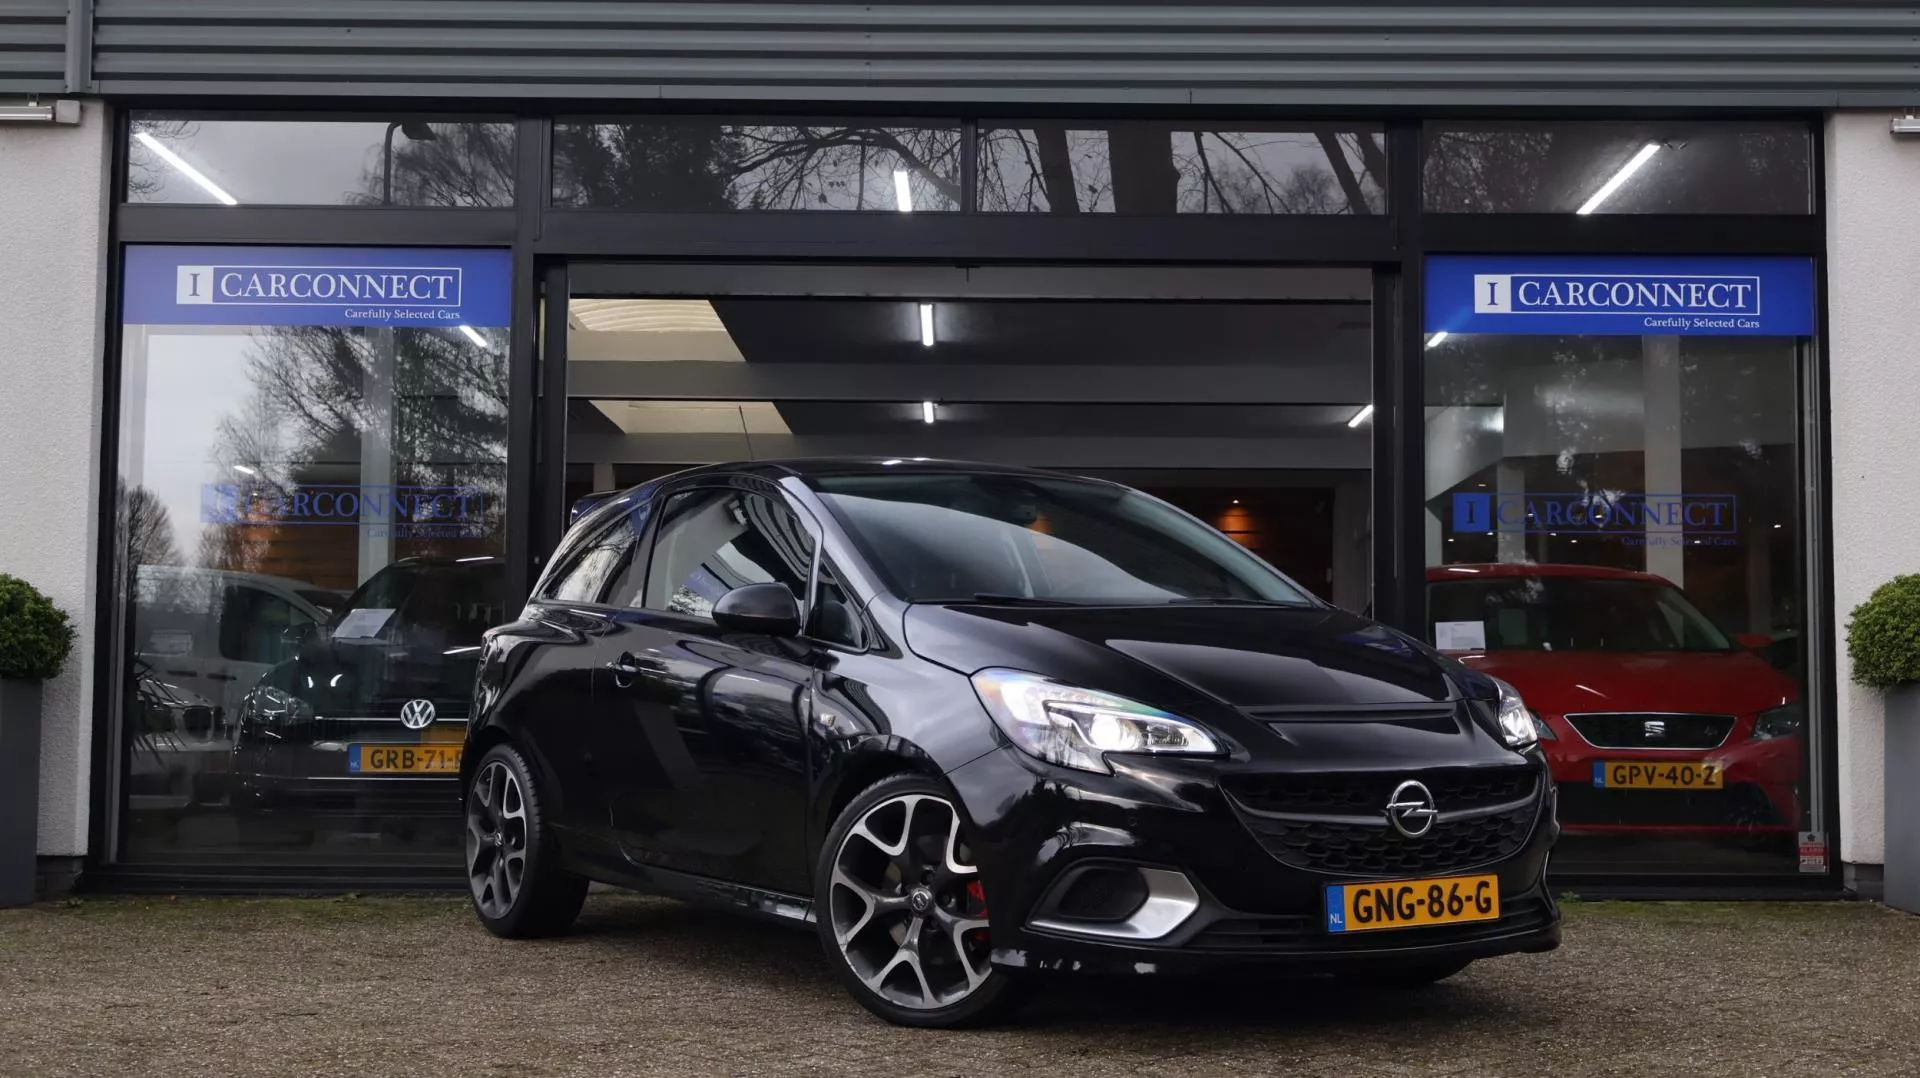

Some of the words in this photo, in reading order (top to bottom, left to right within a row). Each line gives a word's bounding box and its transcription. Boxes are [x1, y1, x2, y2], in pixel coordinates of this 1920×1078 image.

[188, 273, 201, 297] I
[220, 272, 453, 299] CARCONNECT
[1486, 282, 1499, 305] I
[1518, 281, 1751, 308] CARCONNECT
[344, 308, 391, 321] Carefully
[394, 309, 434, 319] Selected
[437, 310, 460, 320] Cars
[1644, 317, 1691, 330] Carefully
[1693, 318, 1734, 328] Selected
[1737, 319, 1760, 329] Cars
[1497, 499, 1729, 527] CARCONNECT
[1613, 765, 1716, 785] GPV-40-Z
[1330, 913, 1343, 924] NL
[1353, 880, 1492, 924] GNG-86-G
